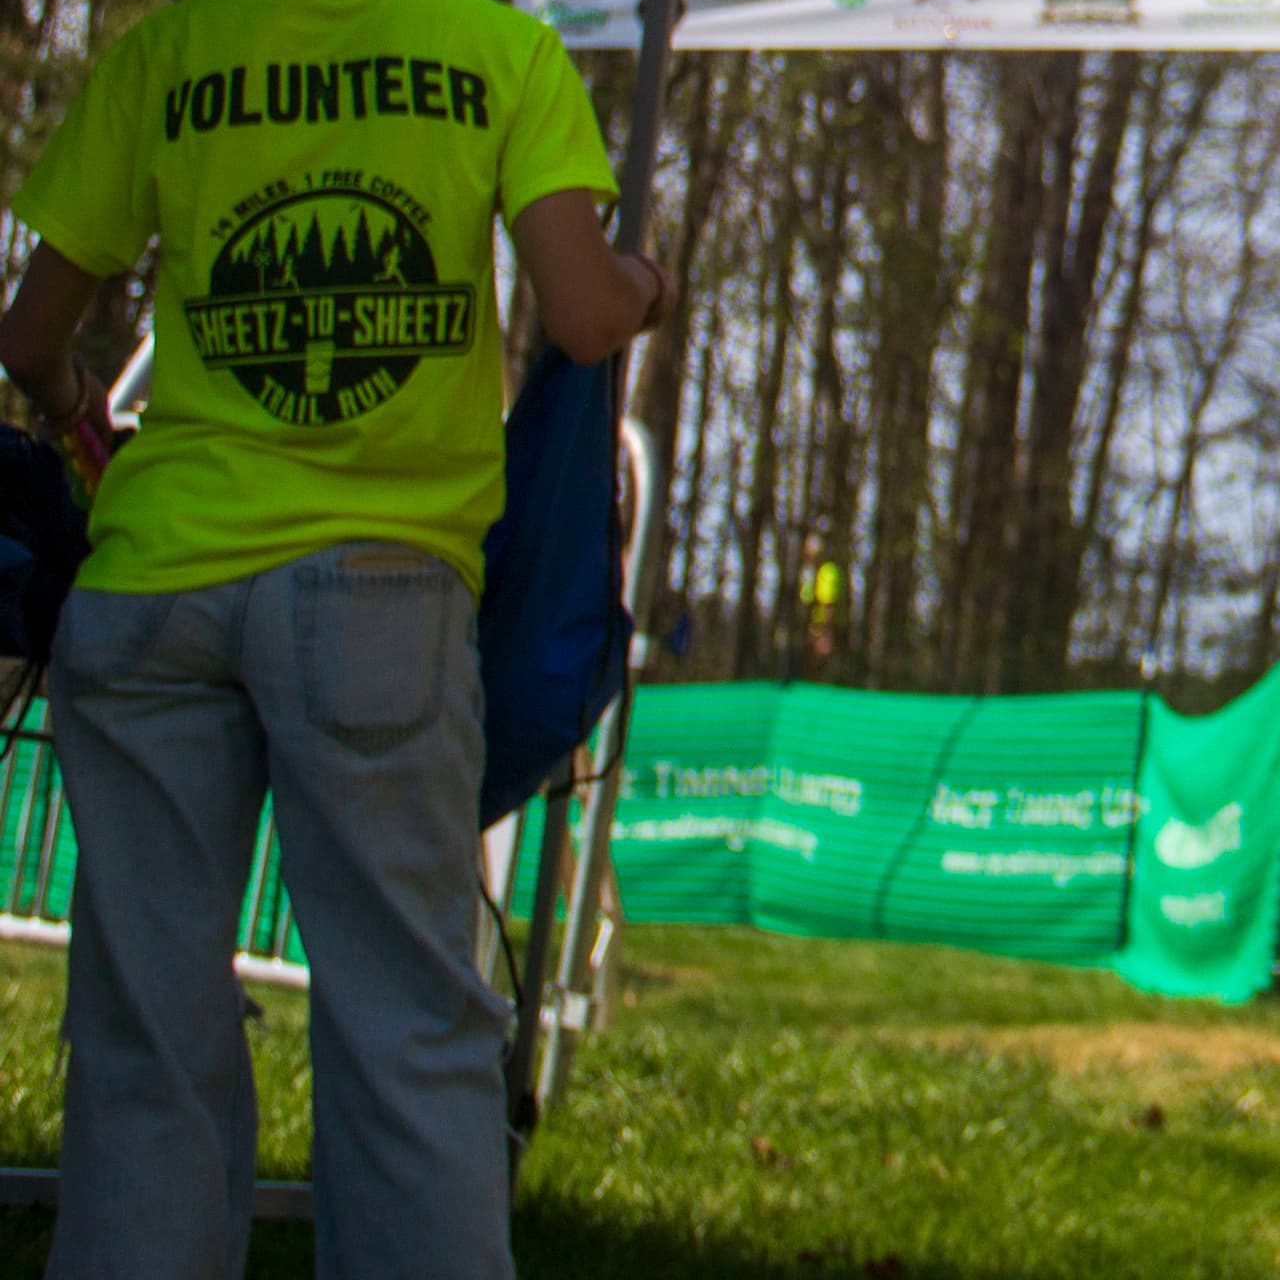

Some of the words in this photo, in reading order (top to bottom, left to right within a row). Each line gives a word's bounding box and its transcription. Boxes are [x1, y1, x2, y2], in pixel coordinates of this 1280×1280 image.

[165, 56, 490, 143] VOLUNTEER
[321, 169, 365, 189] FREE
[259, 373, 325, 425] TRAIL
[336, 367, 400, 419] RUN
